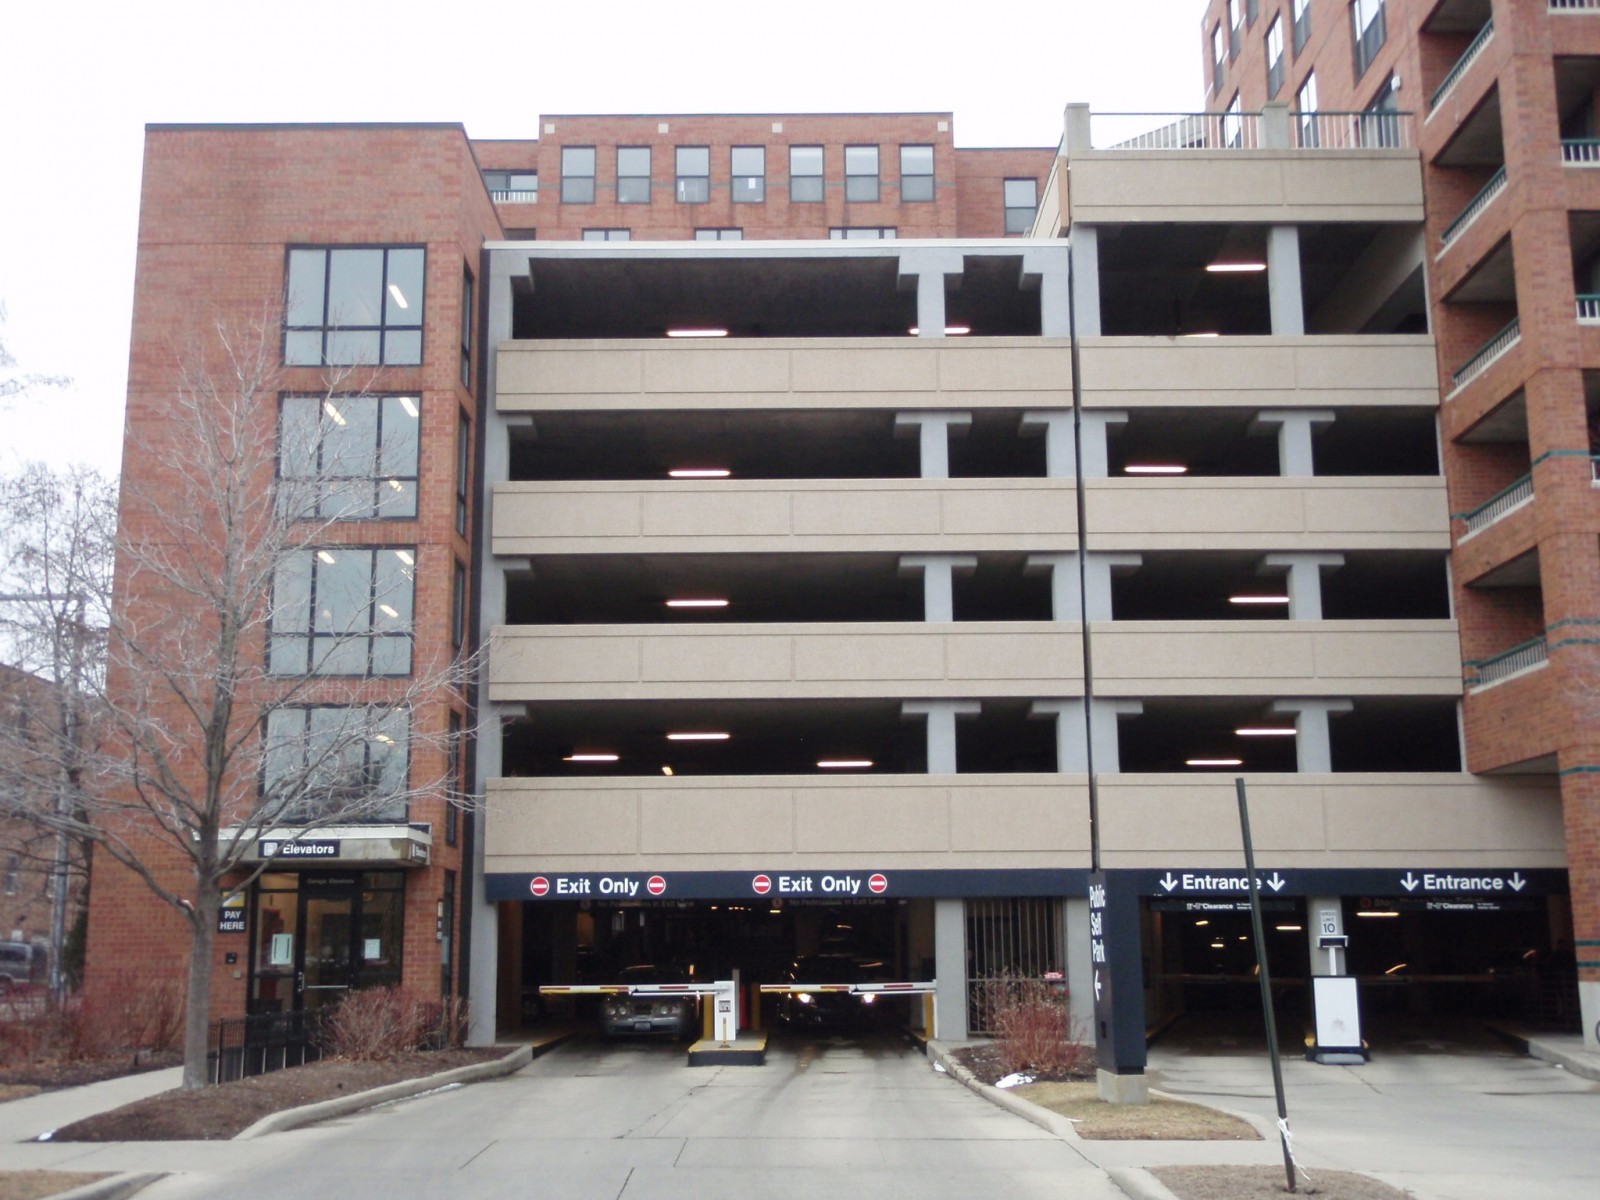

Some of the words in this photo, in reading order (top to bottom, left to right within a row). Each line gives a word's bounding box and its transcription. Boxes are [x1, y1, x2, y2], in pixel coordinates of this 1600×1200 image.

[282, 843, 335, 855] Elevators
[556, 877, 591, 894] Exit
[599, 876, 639, 896] Only
[778, 875, 813, 892] Exit
[821, 874, 861, 894] Only
[1423, 874, 1503, 890] Entrance
[1089, 884, 1106, 908] Public
[1202, 902, 1234, 910] Clearance
[1442, 902, 1474, 910] Clearance
[224, 910, 242, 920] PAY
[219, 921, 245, 930] HERE
[1091, 912, 1103, 936] Self
[1323, 923, 1336, 933] 10
[1092, 939, 1105, 963] Park
